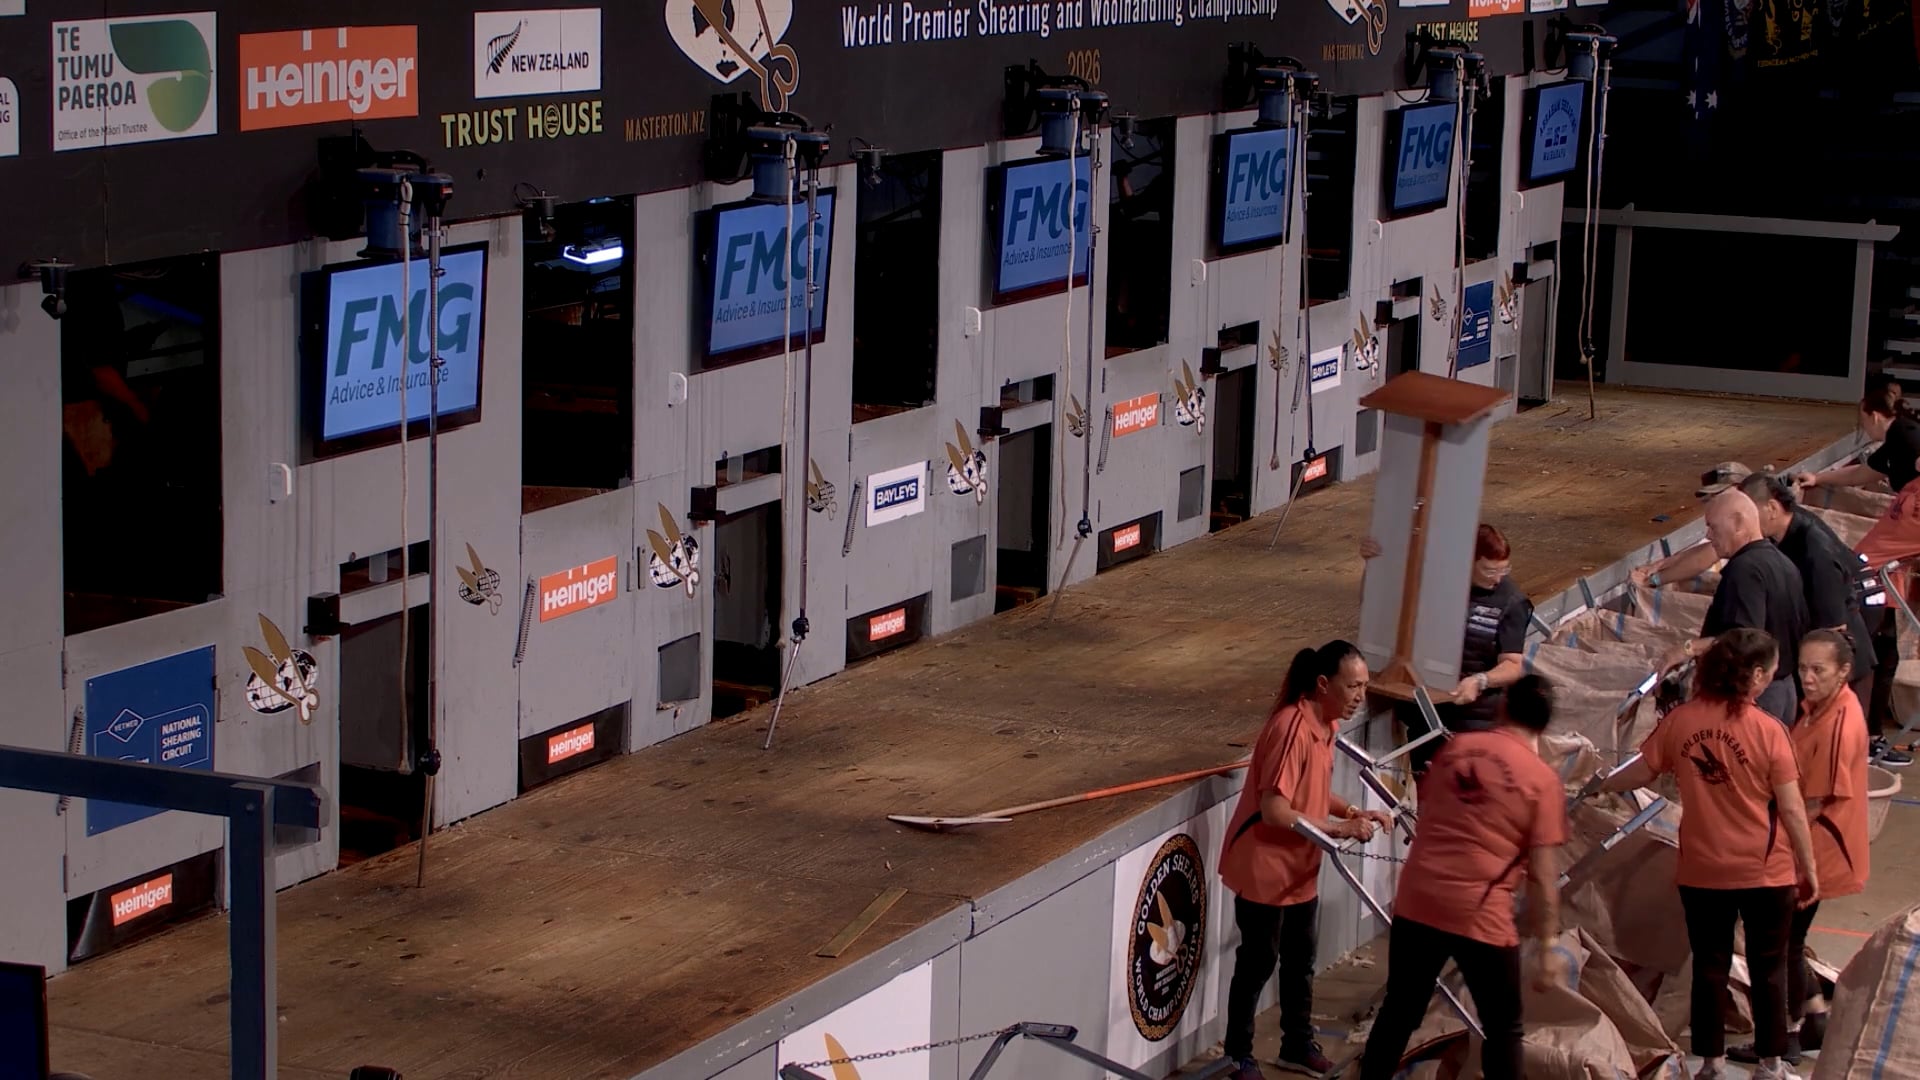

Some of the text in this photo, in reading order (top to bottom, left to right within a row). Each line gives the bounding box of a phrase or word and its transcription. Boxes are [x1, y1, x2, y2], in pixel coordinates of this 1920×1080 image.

[57, 27, 80, 52] TE
[842, 3, 893, 47] World
[902, 1, 971, 42] Premier
[978, 0, 1050, 37] Shearing
[1056, 0, 1083, 29] and
[57, 53, 114, 81] TUMU
[248, 28, 414, 114] Heiniger
[511, 51, 590, 73] NEW ZEALAND
[1067, 49, 1101, 85] 2026
[59, 81, 137, 111] PAEROA
[58, 129, 77, 141] Office
[79, 127, 88, 138] of
[88, 126, 100, 137] the
[122, 122, 148, 135] Trustee
[440, 100, 603, 148] TRUST HOUSE
[625, 110, 706, 142] MASTERTON.NZ
[1400, 121, 1452, 172] FMG
[1229, 147, 1287, 204] FMG
[1006, 178, 1089, 246] FMG
[719, 222, 825, 300] FMG
[1003, 249, 1029, 266] Advice
[1030, 247, 1035, 261] &
[334, 282, 474, 378] FMG
[715, 303, 750, 324] Advice
[750, 301, 757, 317] &
[329, 379, 373, 405] Advice
[376, 375, 386, 395] &
[1115, 396, 1158, 431] Heiniger
[876, 481, 917, 506] BAYLEYS
[544, 564, 616, 612] Heiniger
[161, 714, 202, 736] NATIONAL
[161, 727, 202, 749] SHEARING
[161, 743, 193, 761] CIRCUIT
[550, 729, 594, 757] Heiniger
[1716, 729, 1749, 765] SHEARS
[115, 882, 172, 918] Heiniger
[1137, 853, 1199, 936] GOLDEN SHEARS
[1134, 922, 1199, 1022] WORLD CHAMPIONSHIPS
